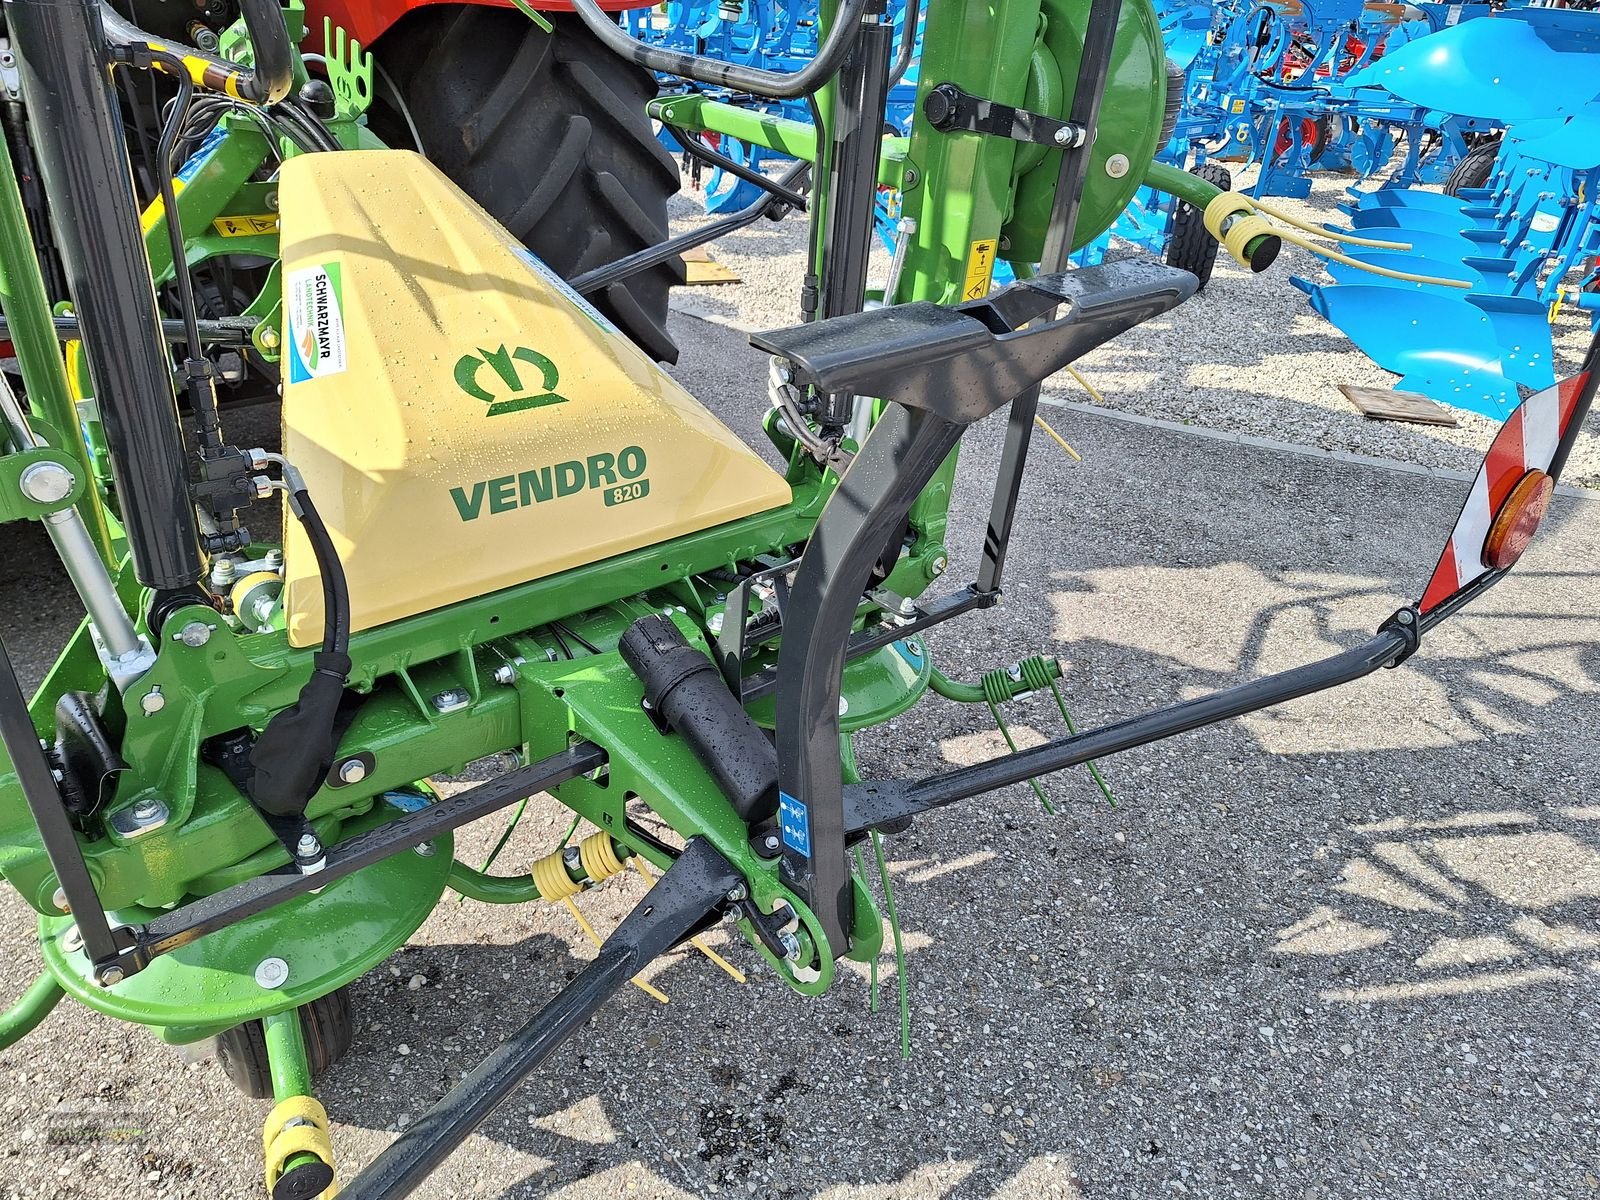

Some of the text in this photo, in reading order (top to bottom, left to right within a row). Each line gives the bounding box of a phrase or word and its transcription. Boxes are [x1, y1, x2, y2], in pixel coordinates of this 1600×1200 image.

[305, 278, 315, 328] LANDTECHNIK
[315, 274, 331, 359] SCHWARZMAYR
[449, 445, 647, 522] VENDRO
[613, 485, 642, 503] 820
